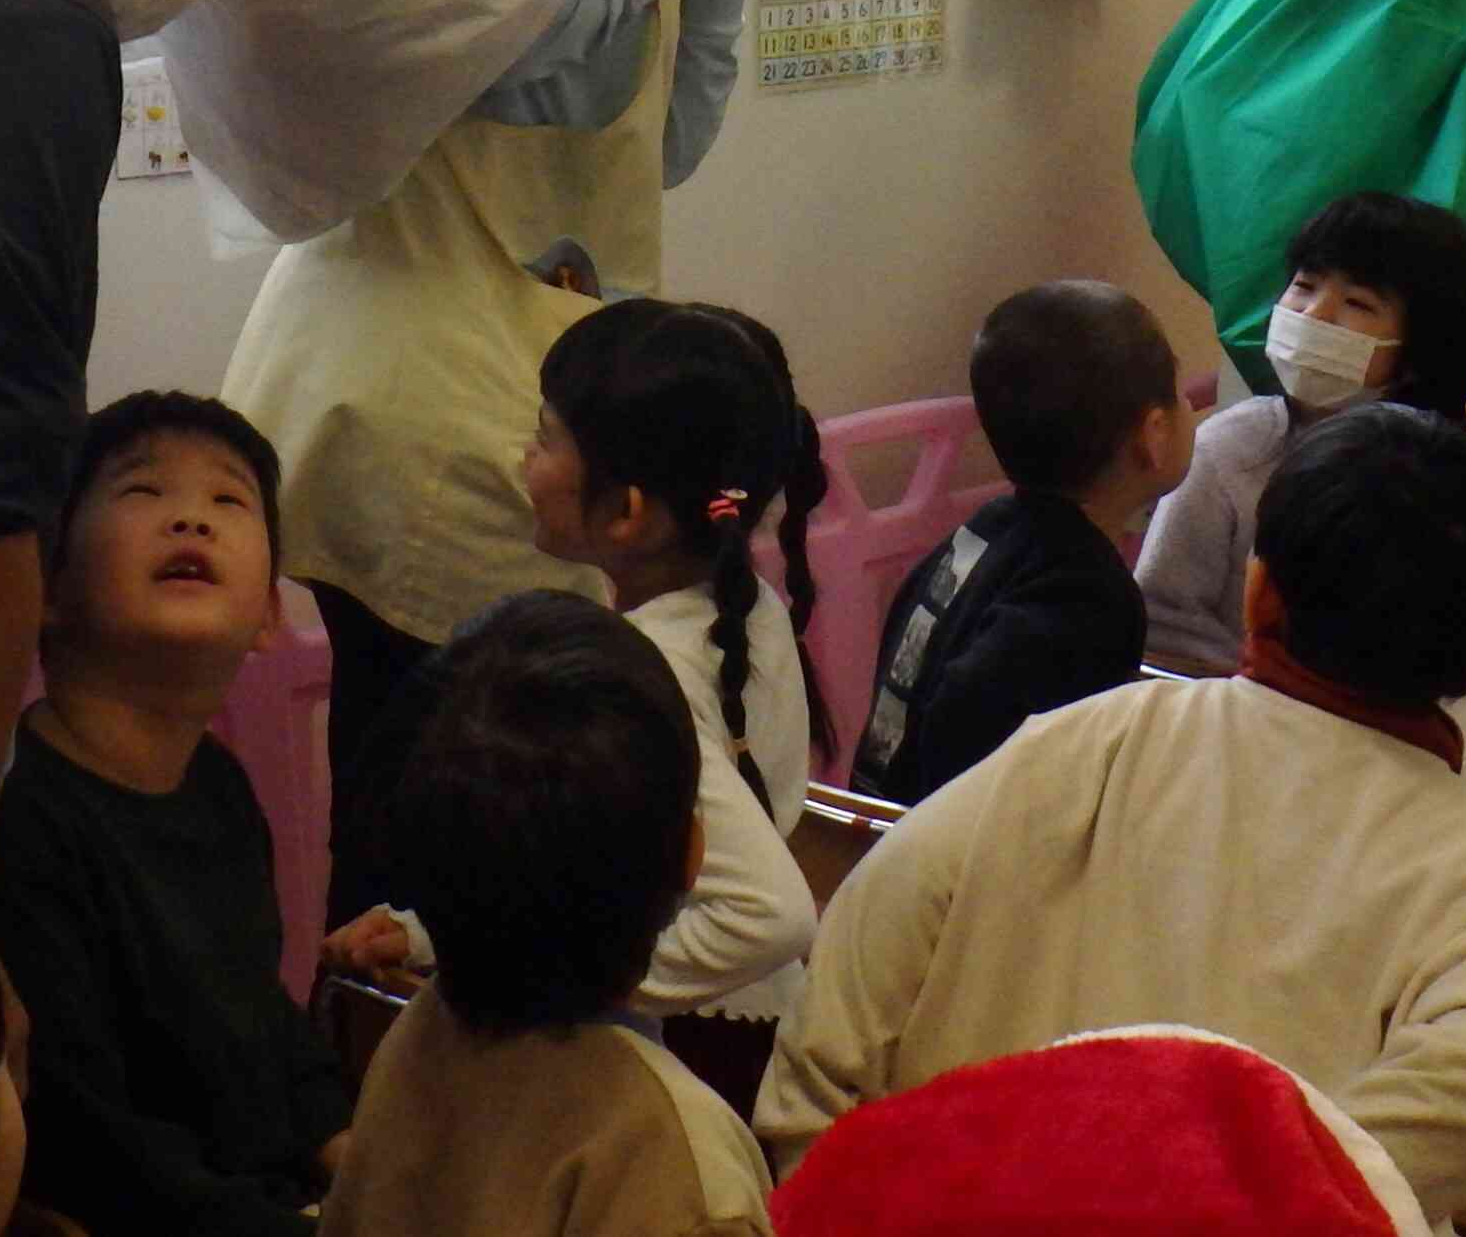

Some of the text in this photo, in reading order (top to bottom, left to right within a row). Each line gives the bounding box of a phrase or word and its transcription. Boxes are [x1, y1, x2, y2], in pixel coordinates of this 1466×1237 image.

[768, 11, 773, 26] 1
[787, 9, 795, 26] 2
[805, 7, 814, 24] 3
[841, 3, 849, 19] 5
[859, 2, 868, 18] 6
[876, 0, 884, 15] 7
[894, 0, 902, 13] 8
[764, 39, 776, 54] 11
[785, 36, 797, 52] 12
[804, 33, 815, 50] 13
[821, 33, 833, 47] 14
[840, 29, 851, 45] 15
[857, 27, 869, 43] 16
[893, 23, 903, 39] 18
[764, 64, 776, 81] 21
[783, 62, 797, 79] 22
[802, 60, 816, 77] 23
[839, 57, 851, 73] 25
